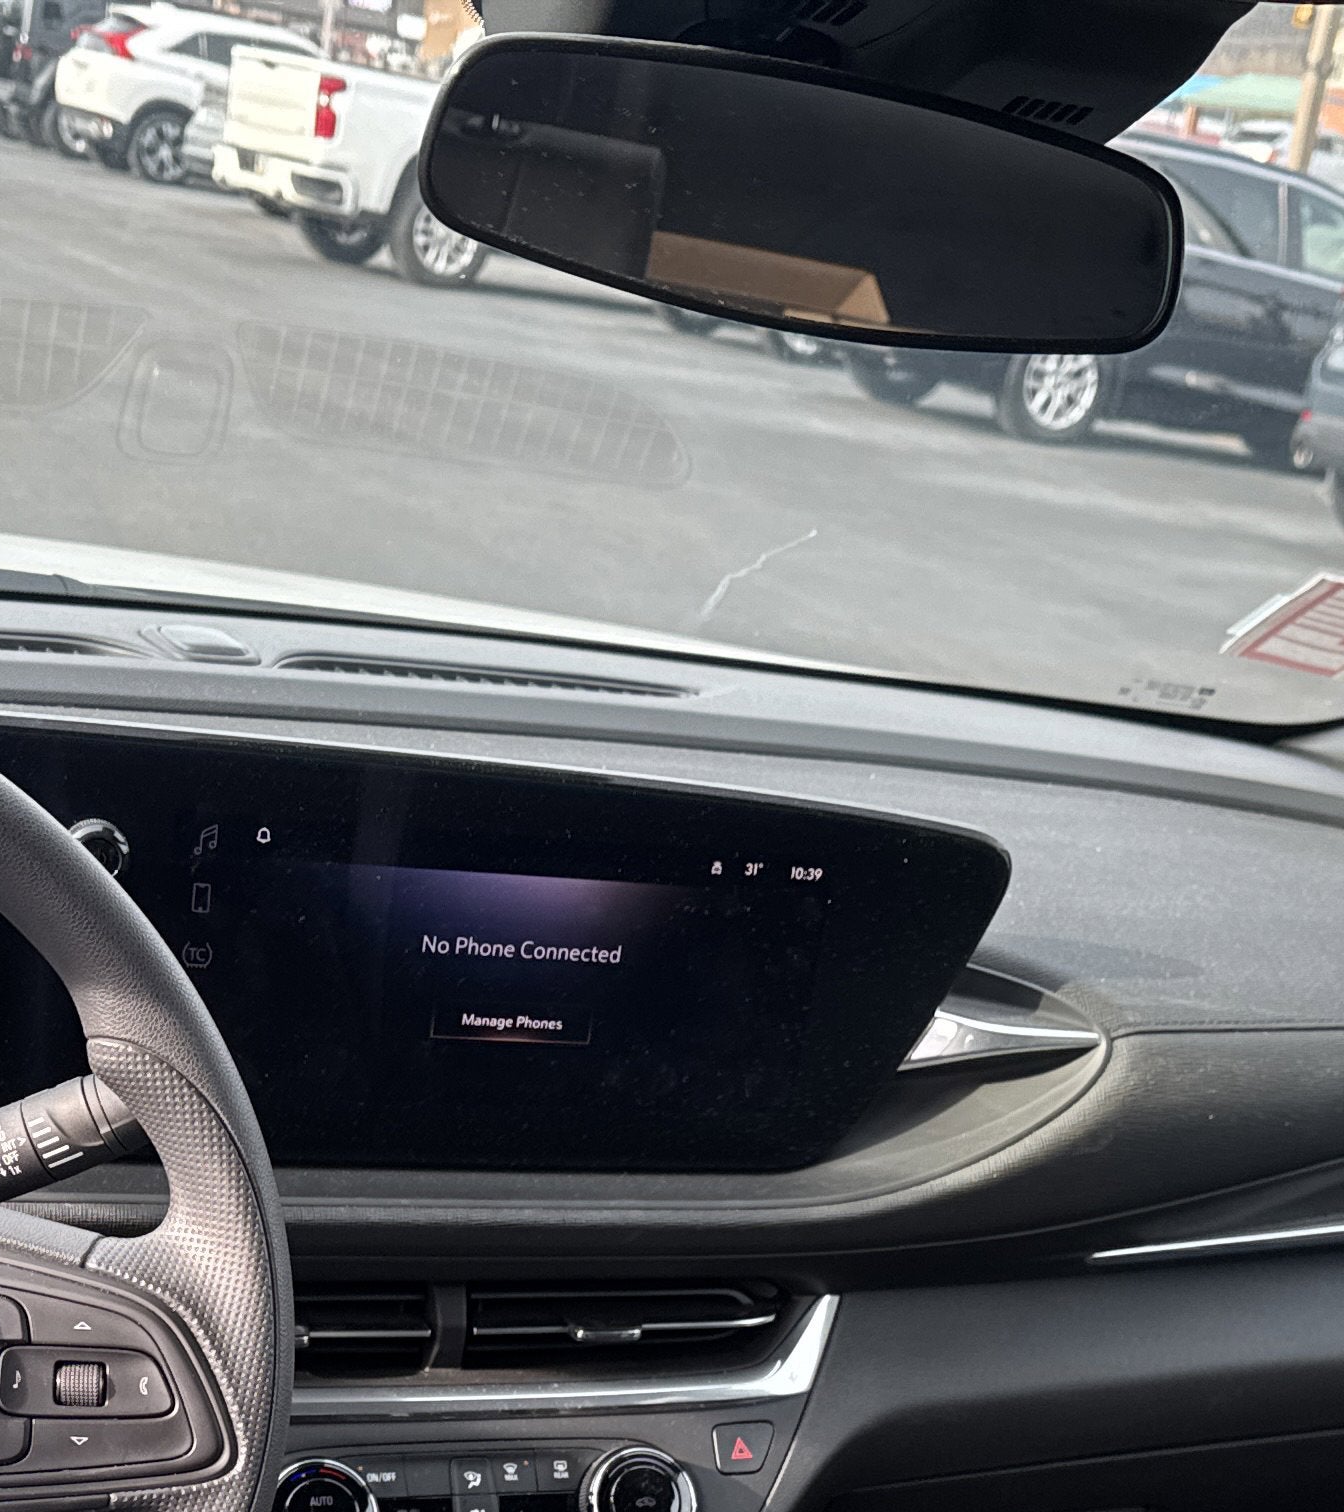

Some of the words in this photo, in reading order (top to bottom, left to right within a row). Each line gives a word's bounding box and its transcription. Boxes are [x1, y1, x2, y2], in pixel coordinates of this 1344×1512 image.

[791, 866, 823, 882] 10:39
[421, 935, 450, 954] No
[455, 936, 515, 958] Phone
[520, 940, 623, 964] Connected
[461, 1013, 513, 1031] Manage
[516, 1015, 563, 1030] Phones
[2, 1150, 19, 1165] OFF
[366, 1472, 396, 1482] ON/OFF
[310, 1495, 333, 1507] AUTO
